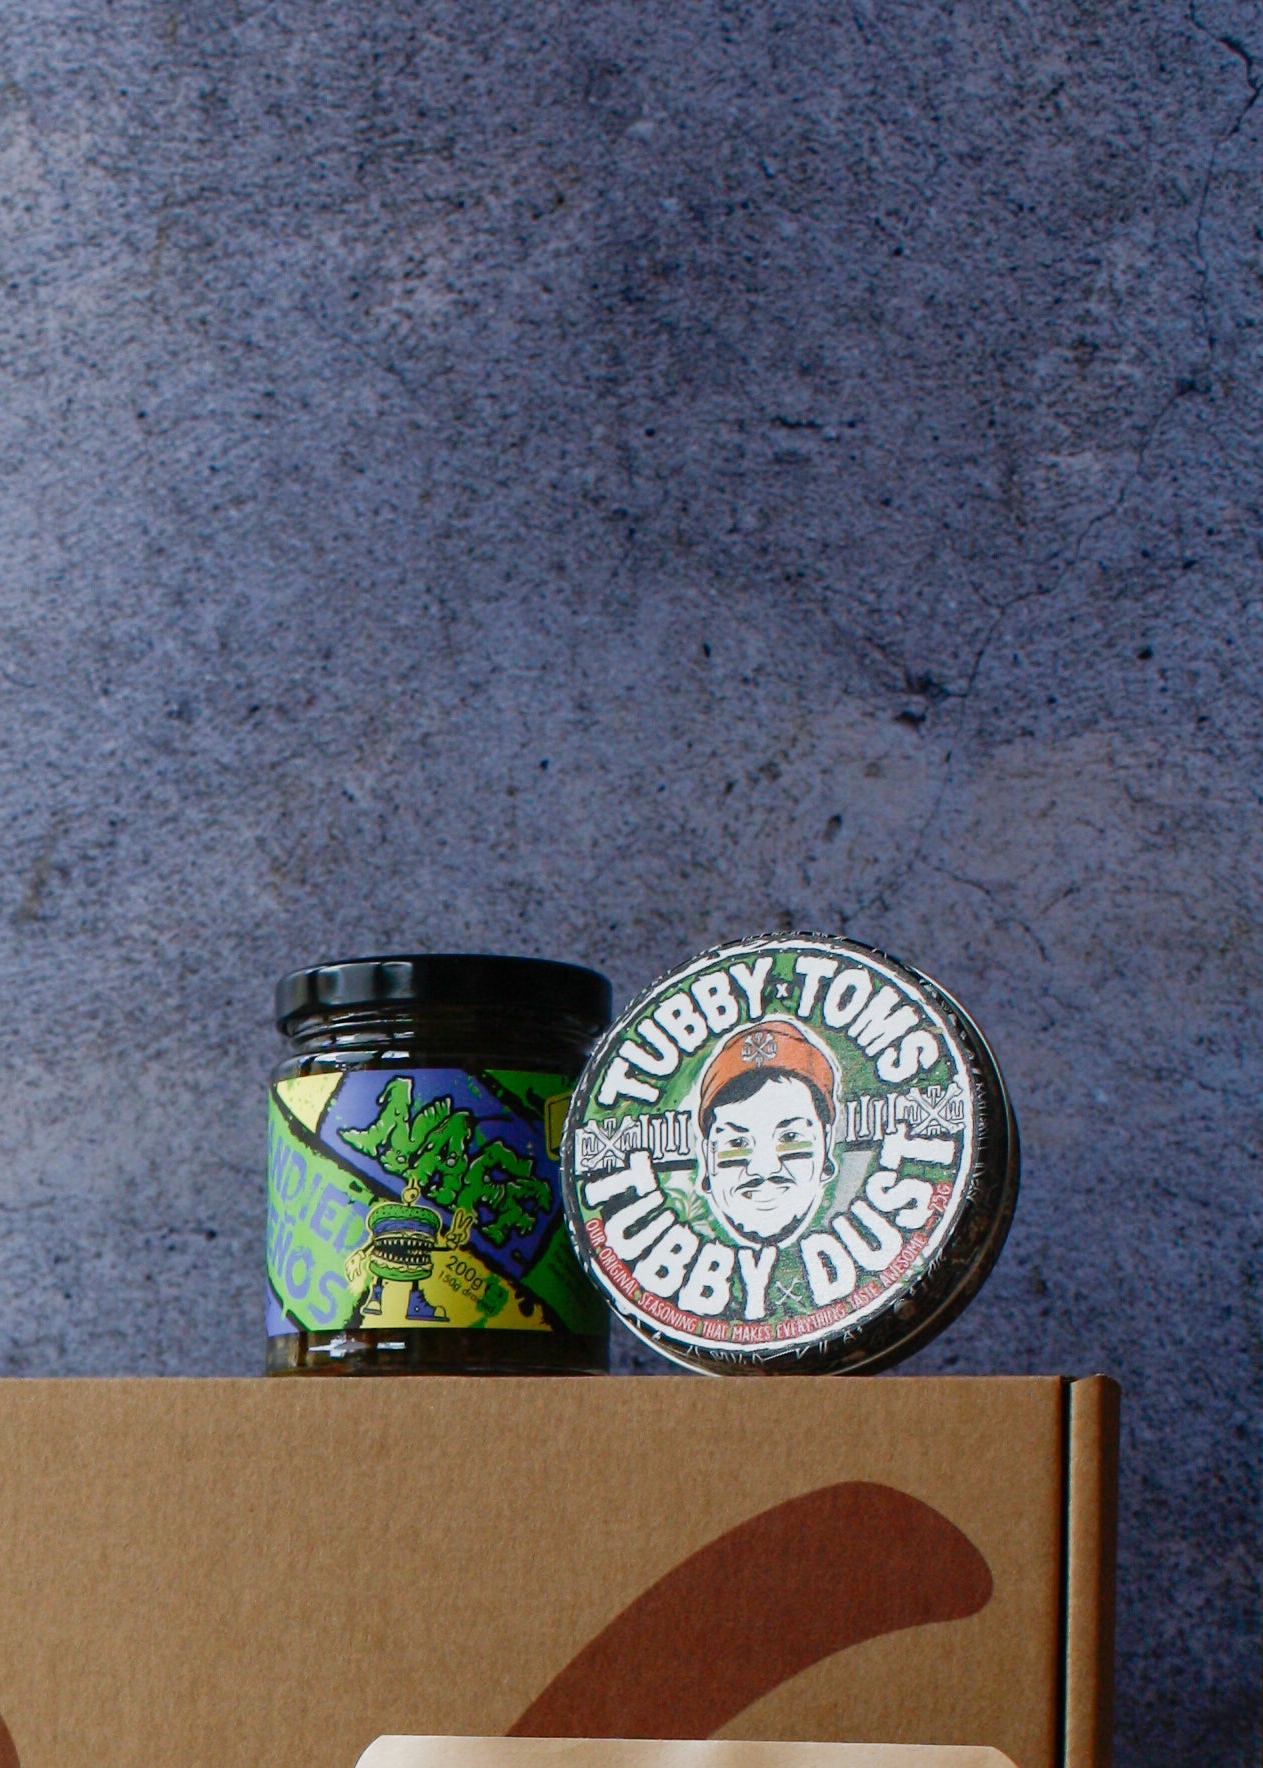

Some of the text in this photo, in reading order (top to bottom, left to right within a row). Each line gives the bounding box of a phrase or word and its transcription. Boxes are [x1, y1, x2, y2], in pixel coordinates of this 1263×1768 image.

[599, 956, 939, 1106] TUBBY TOMS
[445, 1255, 483, 1291] 200g
[586, 1148, 777, 1319] TUBBY
[802, 1121, 955, 1303] DUST
[586, 1220, 607, 1248] OUR
[598, 1249, 638, 1297] ORIGINAL
[638, 1292, 698, 1331] SEASONING
[702, 1321, 728, 1339] THAT
[732, 1325, 772, 1340] MAKES
[776, 1305, 847, 1340] EVERYTHING
[850, 1284, 880, 1310] TASTE
[880, 1234, 927, 1287] AWESOME
